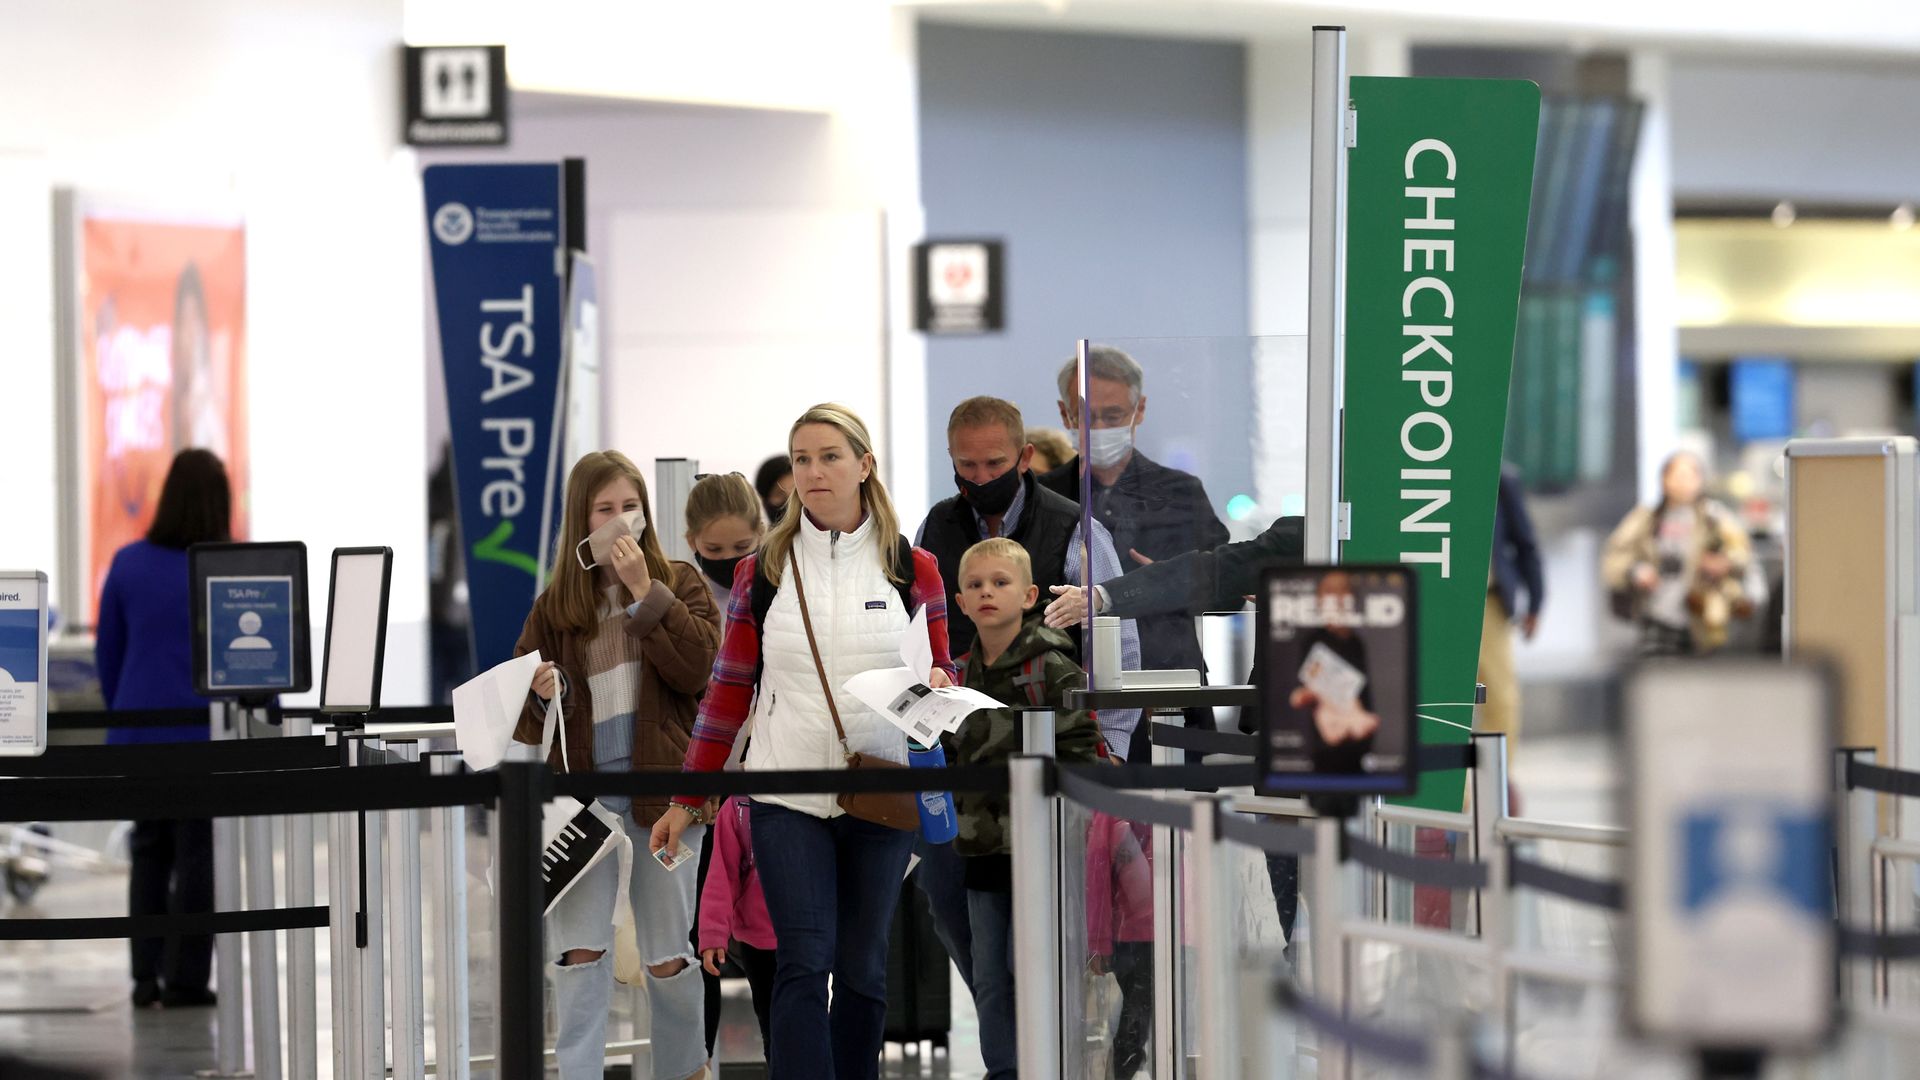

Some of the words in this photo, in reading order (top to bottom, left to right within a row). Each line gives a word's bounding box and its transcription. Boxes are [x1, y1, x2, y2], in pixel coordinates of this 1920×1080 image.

[479, 284, 535, 404] TSA
[1399, 138, 1457, 579] CHECKPOINT
[481, 418, 535, 517] Pre
[228, 589, 245, 599] TSA
[1269, 594, 1363, 628] REAL
[1364, 594, 1405, 628] ID
